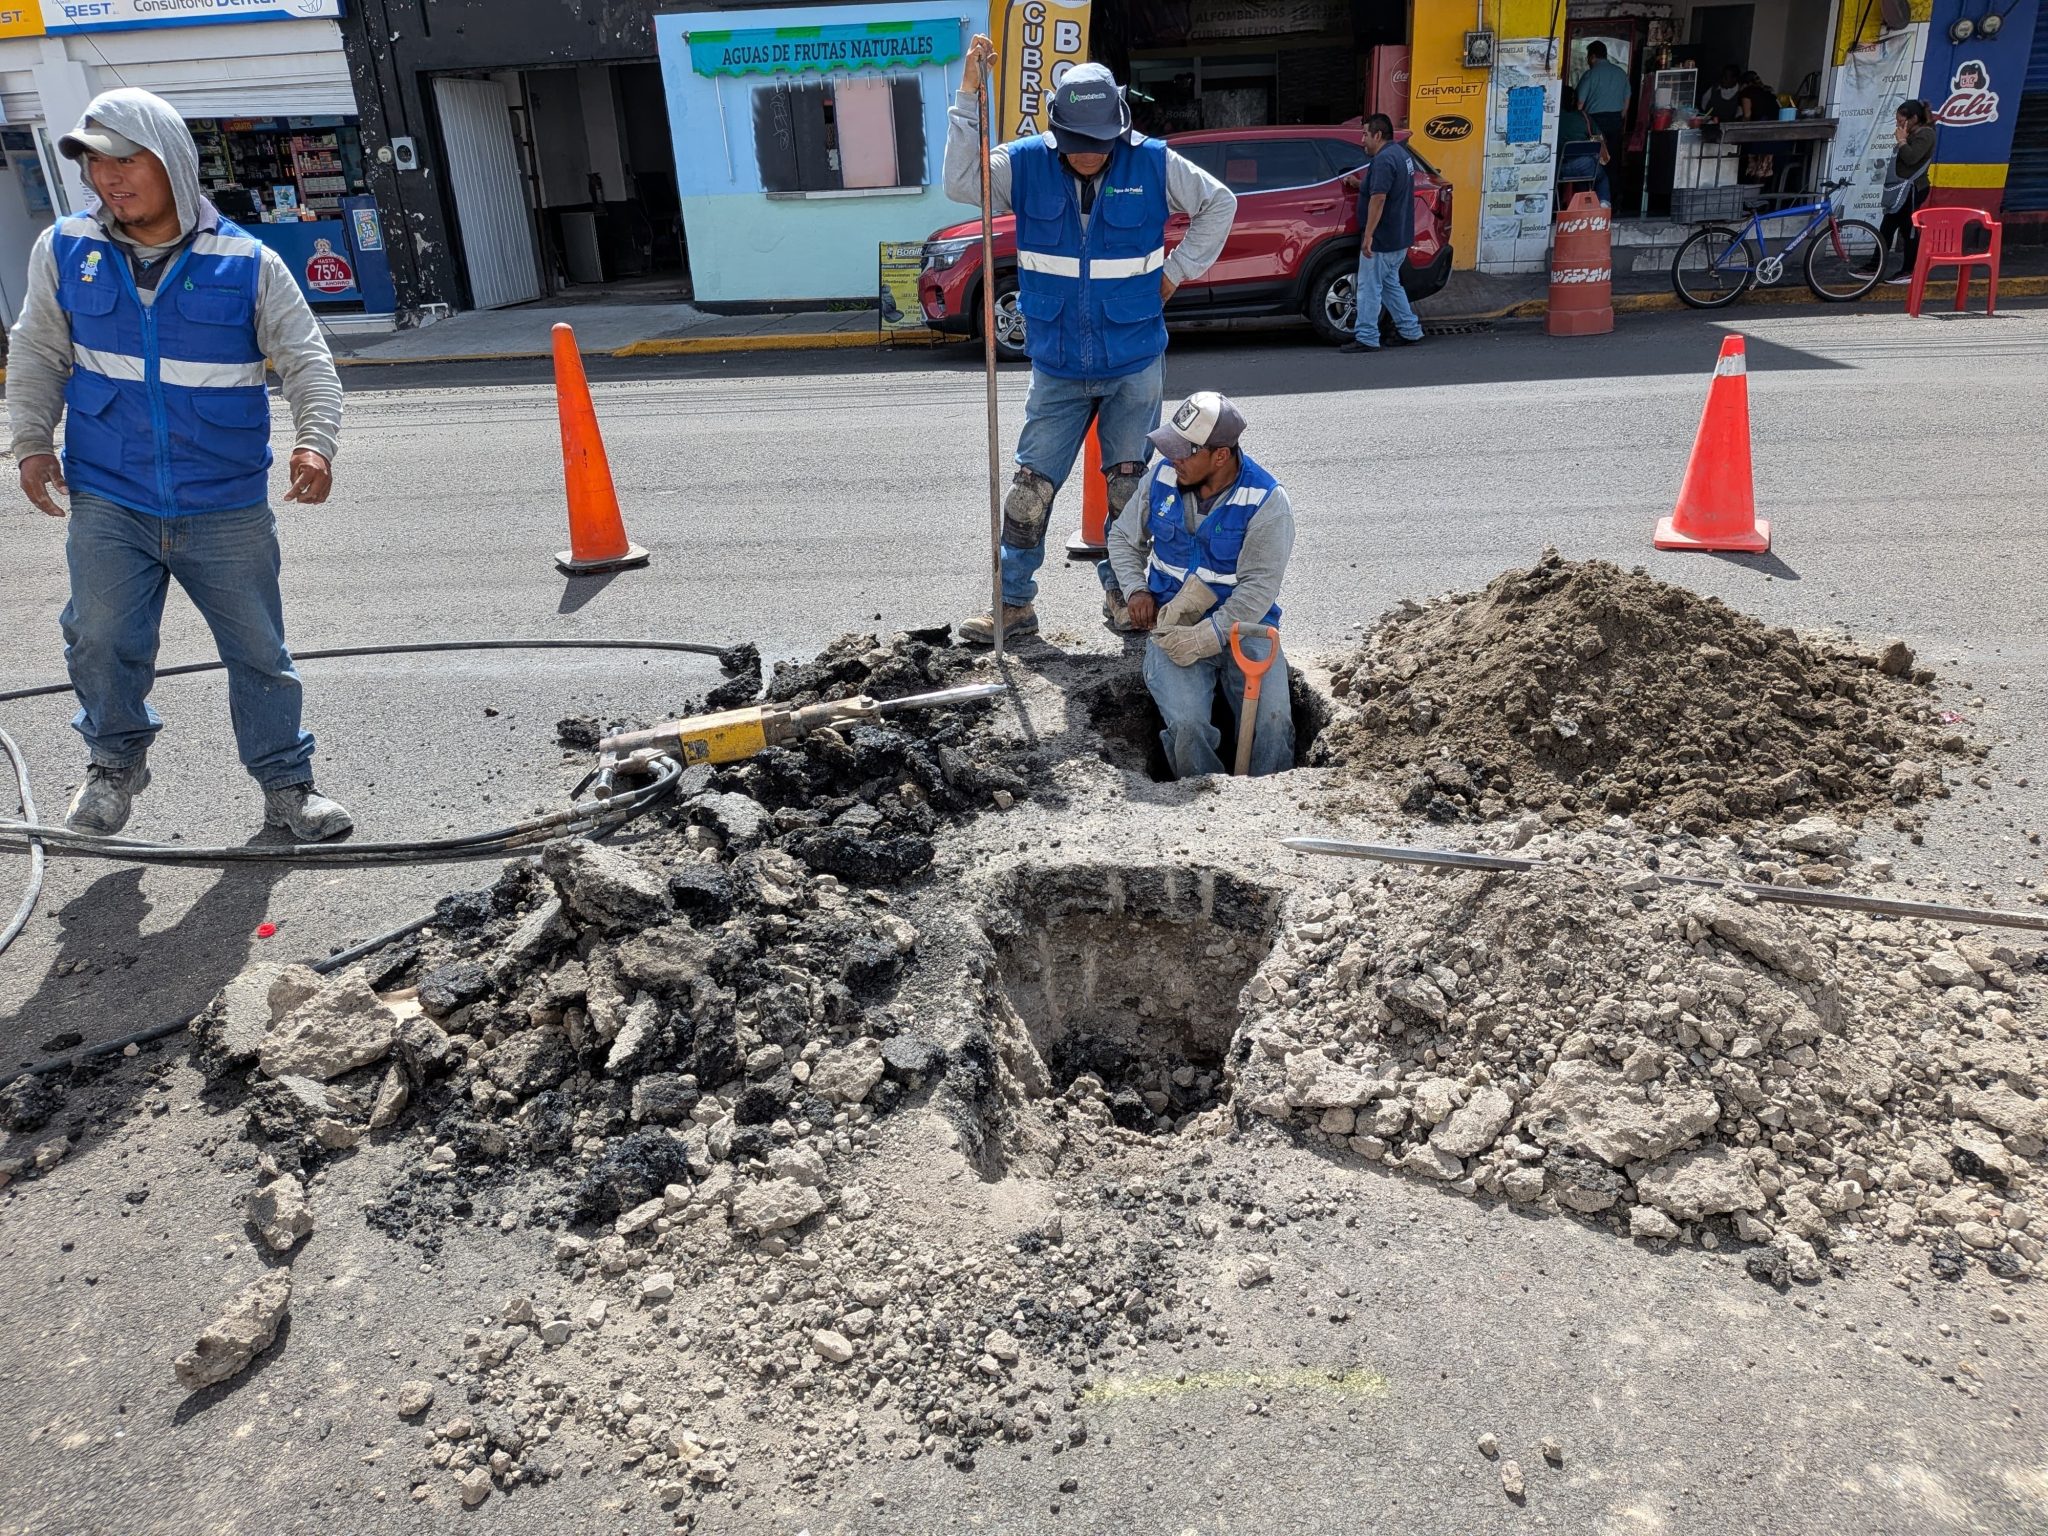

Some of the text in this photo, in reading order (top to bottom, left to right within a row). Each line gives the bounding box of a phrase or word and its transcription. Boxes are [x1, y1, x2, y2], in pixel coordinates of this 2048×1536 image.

[65, 2, 111, 17] BEST
[133, 0, 213, 12] Consultorio
[0, 10, 22, 24] ST
[722, 36, 933, 66] AGUAS DE FRUTAS NATURALES
[1016, 1, 1046, 135] CUBREA
[1421, 85, 1478, 96] CHEVROLET
[1429, 120, 1469, 136] Ford
[1853, 202, 1883, 210] NATURALE
[896, 247, 922, 257] Bonill
[314, 264, 344, 280] 75%
